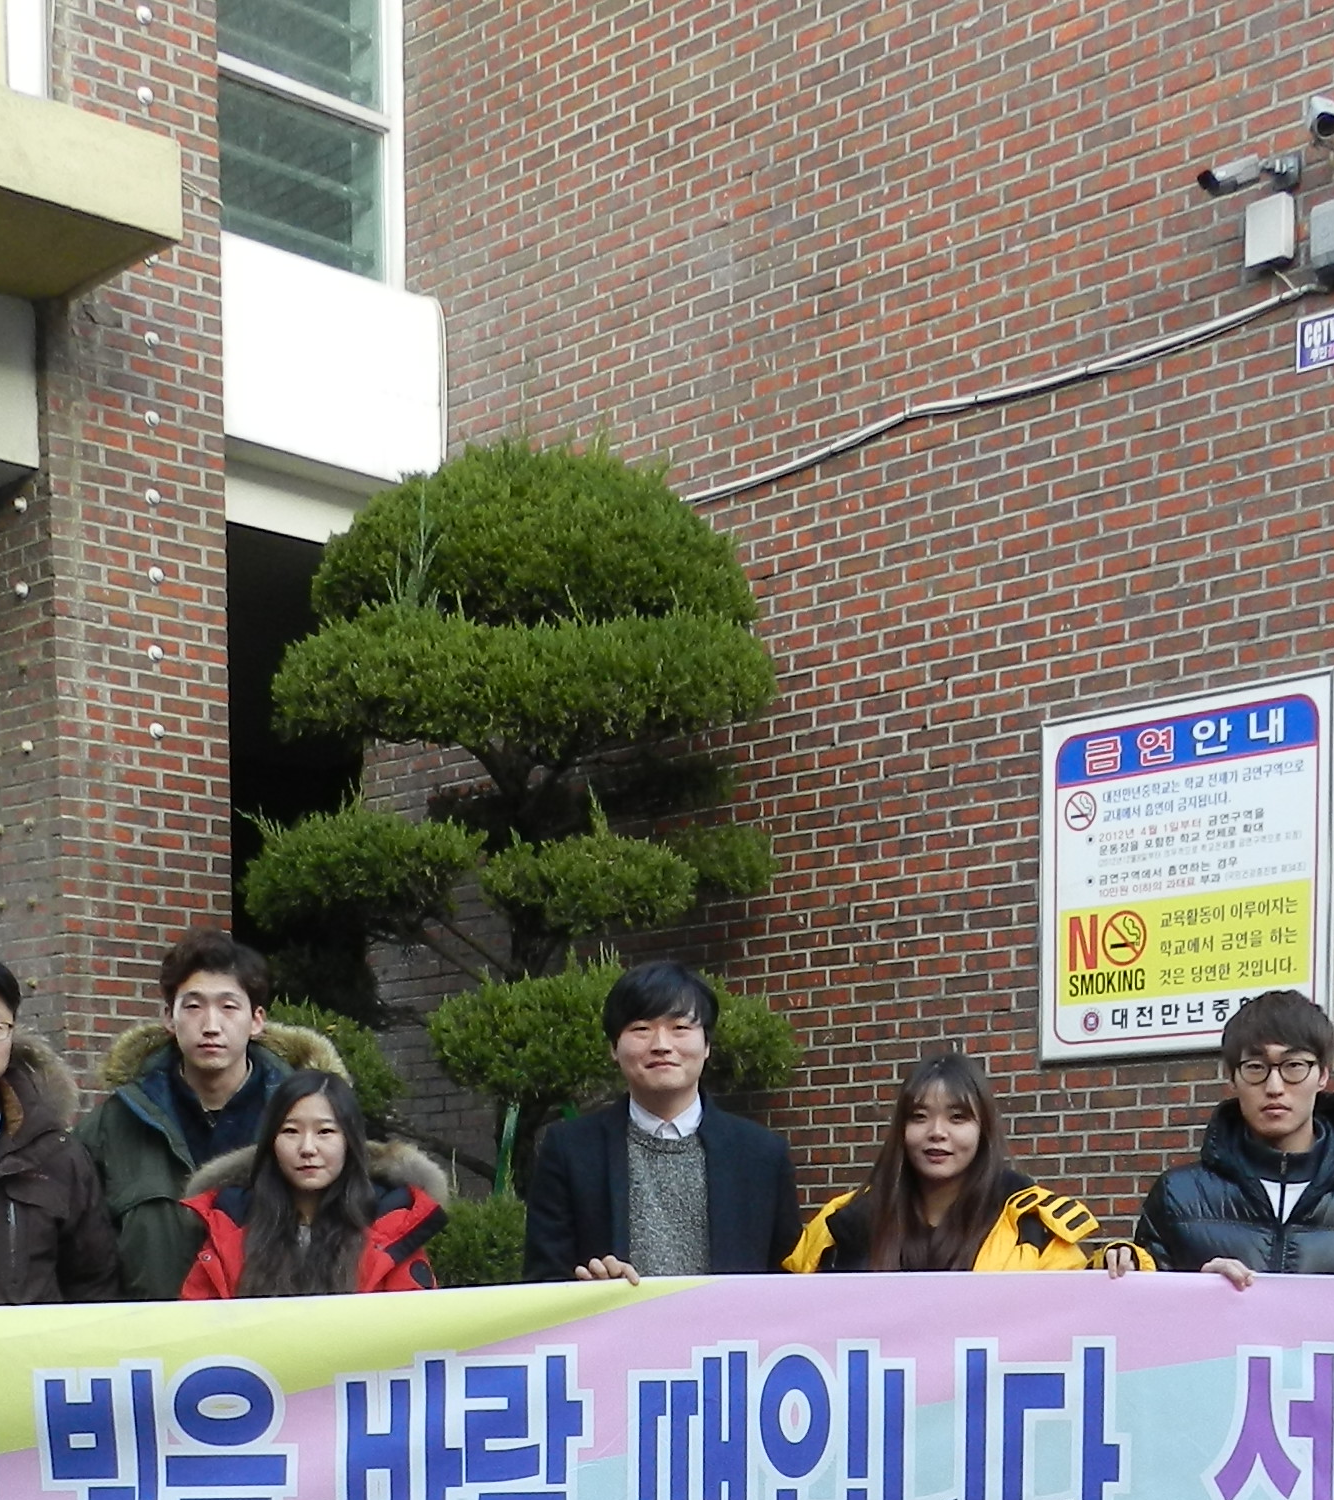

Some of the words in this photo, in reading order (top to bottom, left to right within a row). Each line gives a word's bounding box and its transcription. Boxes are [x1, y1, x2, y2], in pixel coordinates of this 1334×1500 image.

[1085, 726, 1175, 777] 금연
[1191, 706, 1286, 756] 안내
[1102, 780, 1180, 804] 대전만년중학교는
[1184, 775, 1204, 790] 학교
[1242, 759, 1305, 781] 금연구역으로
[1103, 804, 1141, 823] 교내에서
[1145, 800, 1174, 817] 흡연이
[1177, 790, 1231, 812] 금지됩니다.
[1099, 828, 1135, 843] 2012년
[1140, 824, 1158, 836] 4월
[1163, 818, 1202, 833] 1일부터
[1208, 807, 1265, 827] 금연구역을
[1099, 841, 1139, 856] 운동장을
[1180, 832, 1201, 843] 학교
[1242, 822, 1264, 834] 확대
[1099, 867, 1162, 886] 금연구역에서
[1168, 861, 1211, 876] 흡연하는
[1217, 856, 1238, 870] 경우
[1099, 884, 1128, 898] 10만원
[1133, 881, 1162, 894] 이하의
[1200, 873, 1220, 884] 부과
[1160, 905, 1225, 929] 교육활동이
[1230, 897, 1298, 920] 이루어지는
[1160, 935, 1214, 957] 학교에서
[1220, 930, 1263, 950] 금연을
[1270, 927, 1298, 945] 하는
[1069, 968, 1145, 997] SMOKING
[1159, 967, 1185, 986] 것은
[1191, 962, 1231, 983] 당연한
[1236, 956, 1298, 979] 것입니다.
[1111, 997, 1253, 1029] 대전만년중
